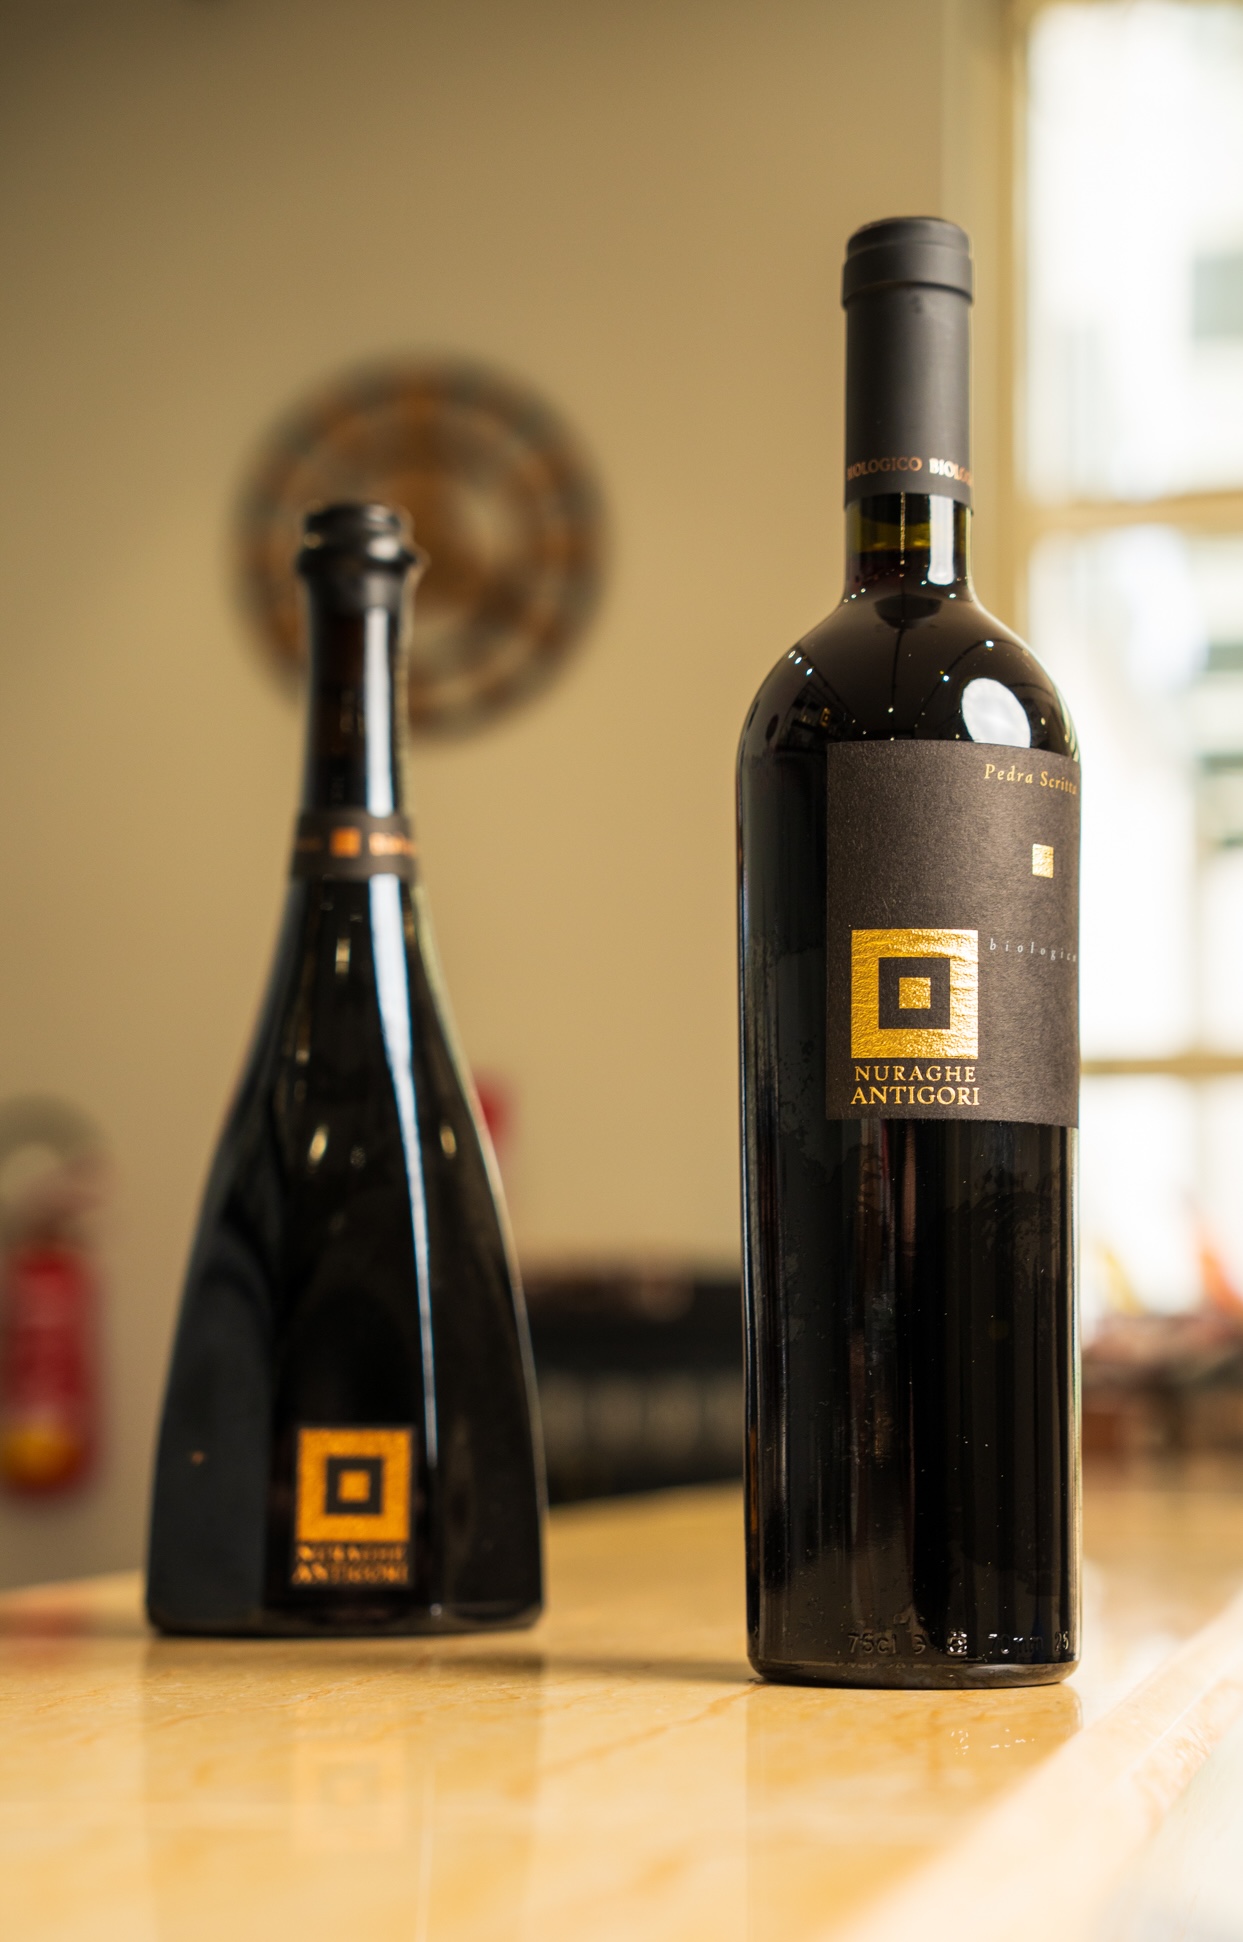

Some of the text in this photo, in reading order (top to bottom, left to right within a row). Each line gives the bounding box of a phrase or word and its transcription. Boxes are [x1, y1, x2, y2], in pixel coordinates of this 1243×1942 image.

[984, 763, 1078, 796] Pedra Scritta
[854, 1065, 977, 1083] NURAGHE
[850, 1085, 981, 1107] ANTIGORI
